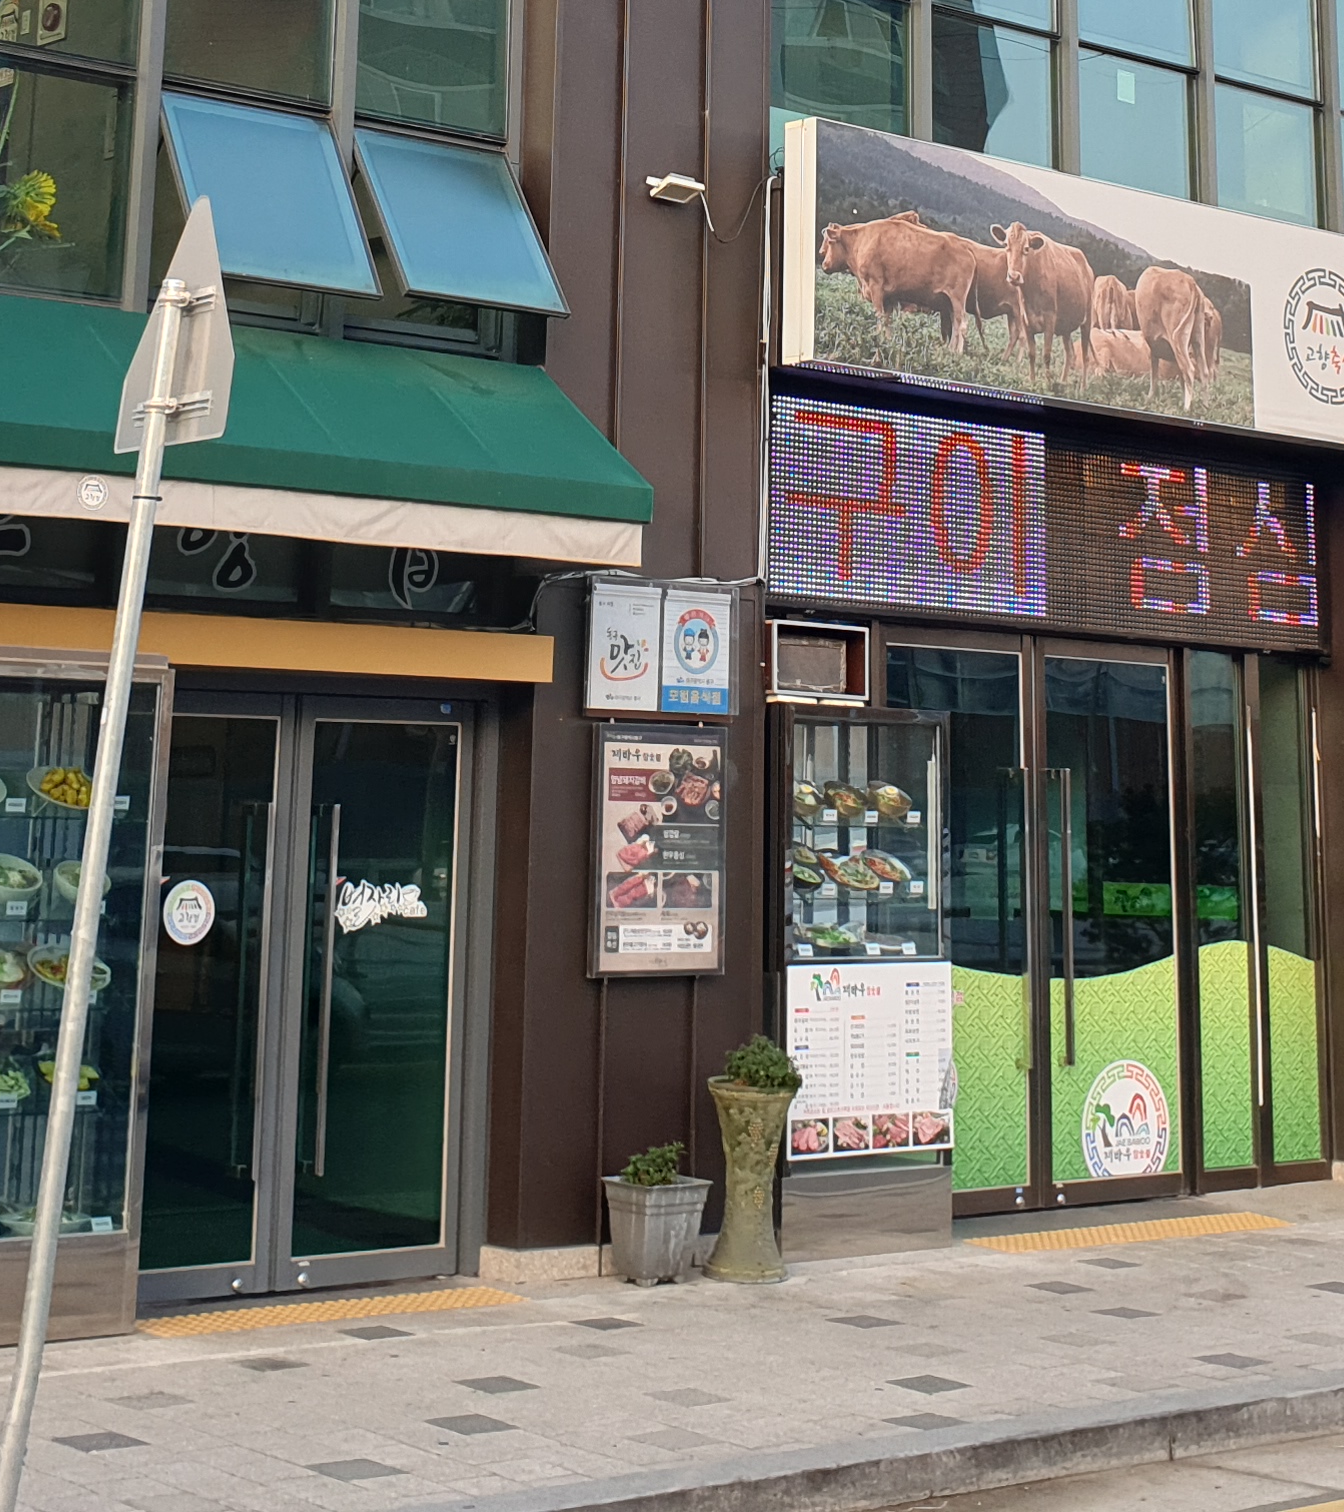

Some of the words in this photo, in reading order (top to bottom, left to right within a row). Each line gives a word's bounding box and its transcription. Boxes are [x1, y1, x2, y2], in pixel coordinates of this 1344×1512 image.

[786, 410, 1027, 596] 구이
[1118, 464, 1319, 627] 점심
[610, 634, 642, 674] 맛집
[668, 688, 722, 706] 모범음식점
[611, 747, 641, 763] 재바우
[340, 880, 401, 921] 별자리
[402, 904, 426, 916] cafe
[842, 982, 866, 998] 재바우
[1103, 1147, 1132, 1164] 재바우
